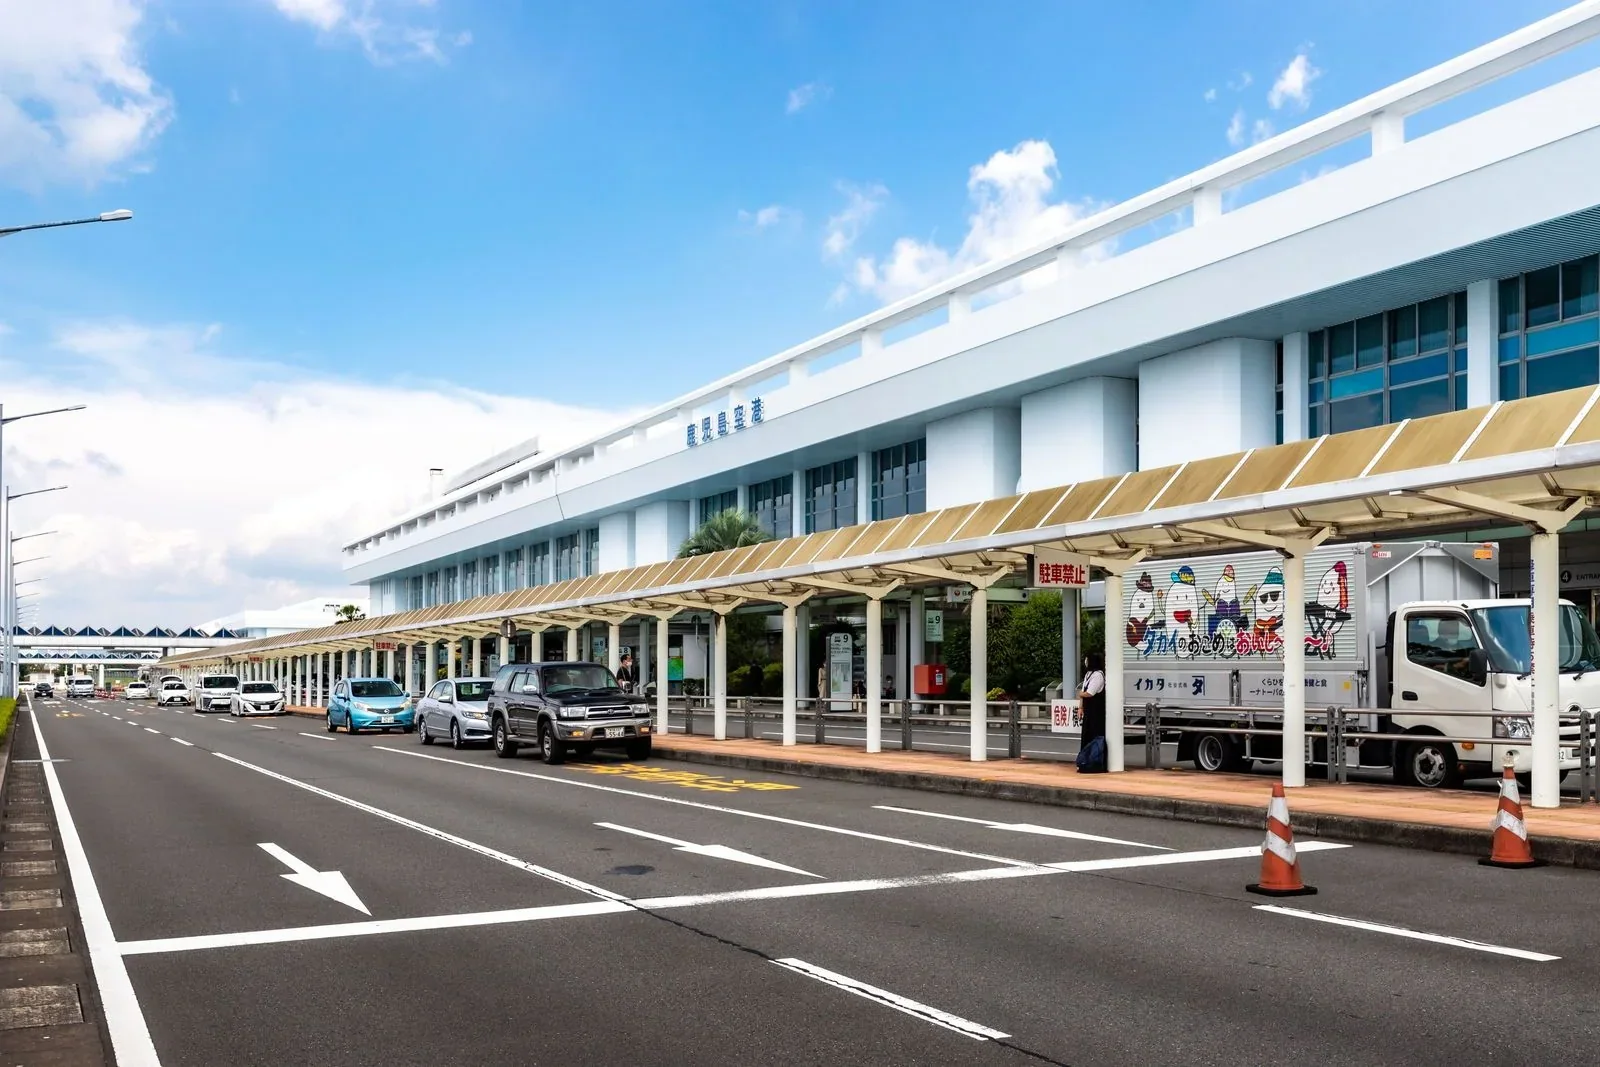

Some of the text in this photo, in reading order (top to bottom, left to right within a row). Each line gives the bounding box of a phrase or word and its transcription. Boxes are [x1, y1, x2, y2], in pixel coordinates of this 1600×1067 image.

[687, 396, 764, 447] 鹿児島空港
[1039, 562, 1086, 584] 駐車禁止
[935, 615, 940, 624] 9
